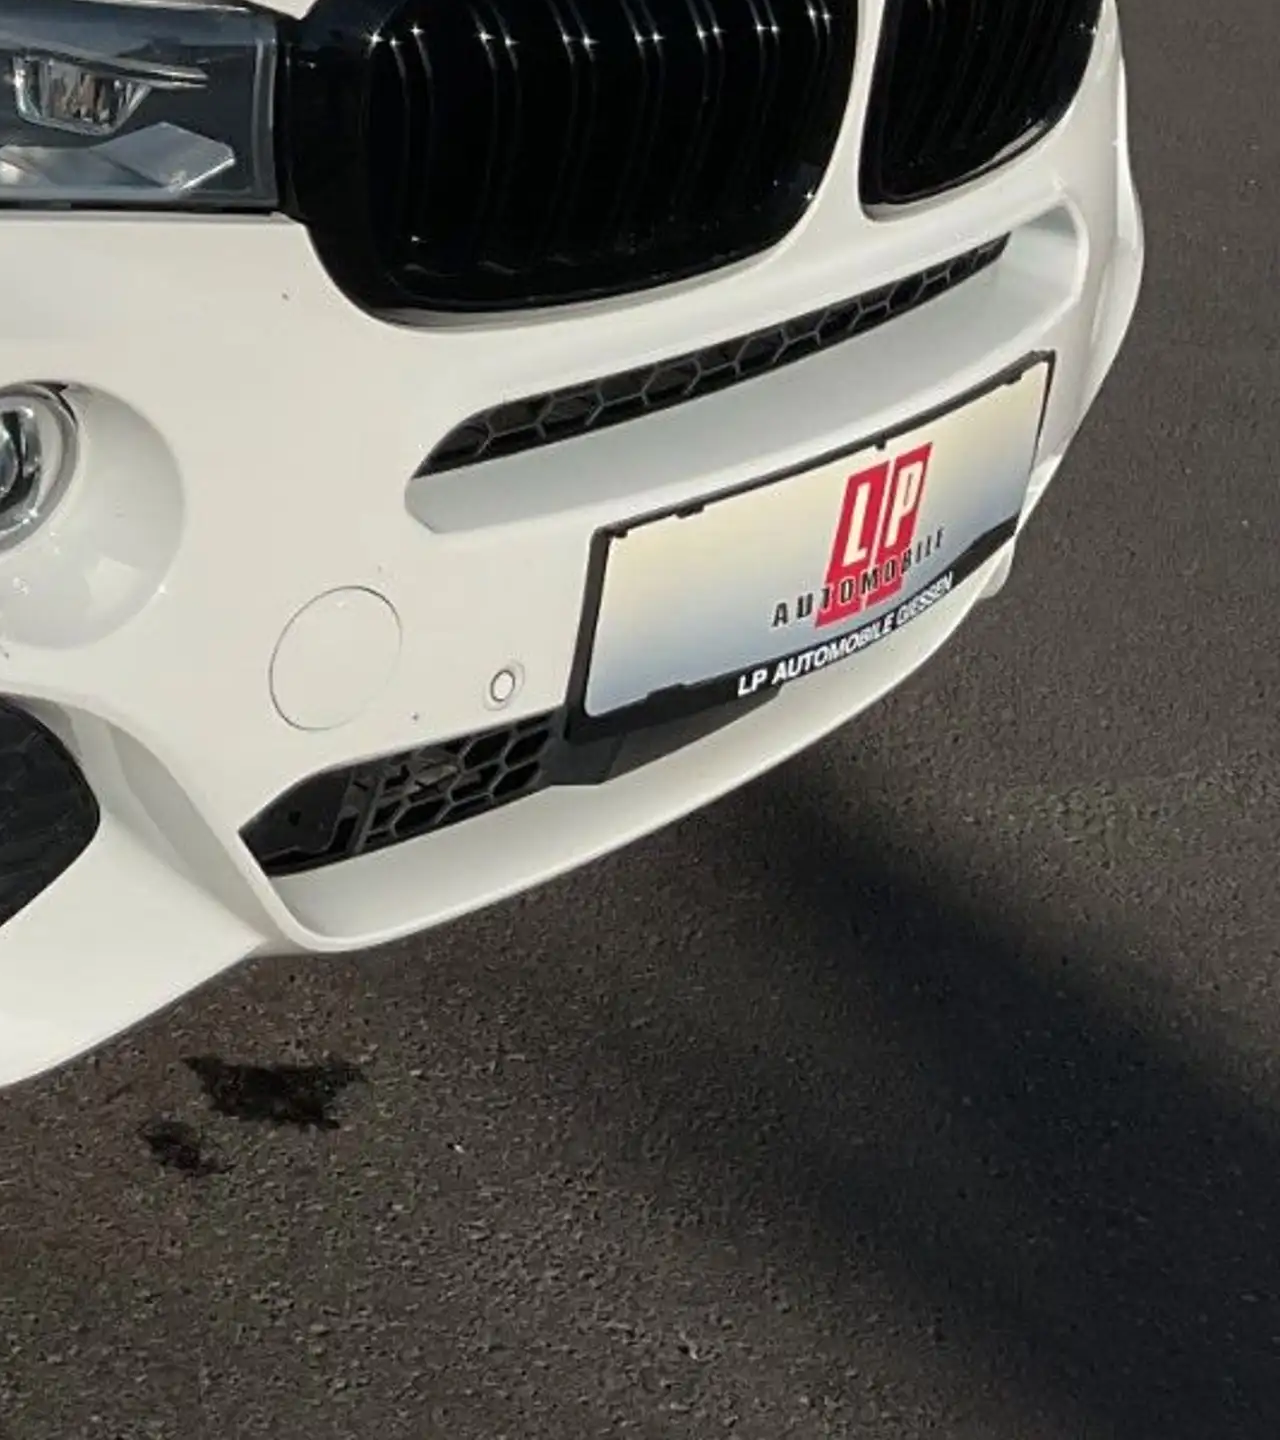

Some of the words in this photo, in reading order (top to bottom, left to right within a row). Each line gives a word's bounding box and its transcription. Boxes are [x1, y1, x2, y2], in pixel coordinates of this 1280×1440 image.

[842, 460, 923, 567] LP
[771, 525, 945, 628] AUTOMOBILE
[737, 668, 768, 697] LP
[771, 614, 895, 685] AUTOMOBILE
